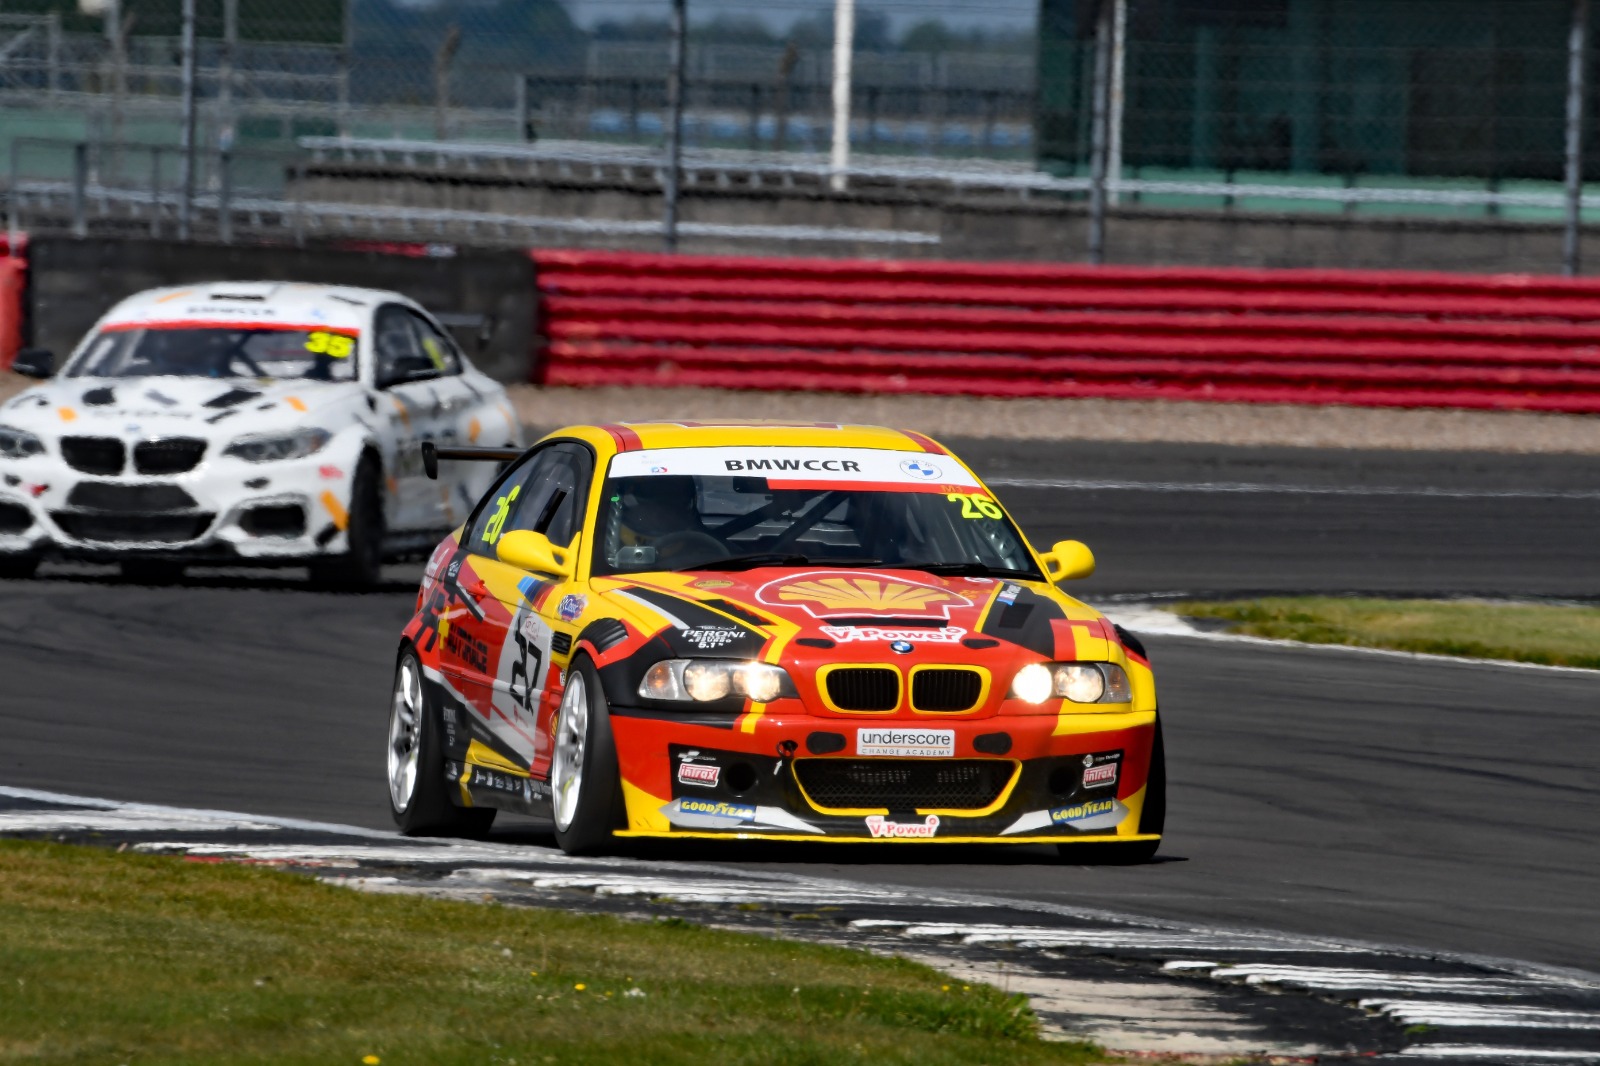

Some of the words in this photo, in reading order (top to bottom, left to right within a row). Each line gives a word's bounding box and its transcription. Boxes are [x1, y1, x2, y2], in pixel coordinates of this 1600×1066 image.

[305, 331, 354, 358] 35
[724, 459, 861, 473] BMWCCR
[947, 493, 1003, 520] 26
[481, 485, 521, 545] 26
[682, 630, 746, 638] PERONI
[828, 630, 956, 641] V-Power
[862, 731, 951, 746] underscore
[1052, 801, 1112, 820] GOODYEAR
[870, 824, 934, 835] V-Power
